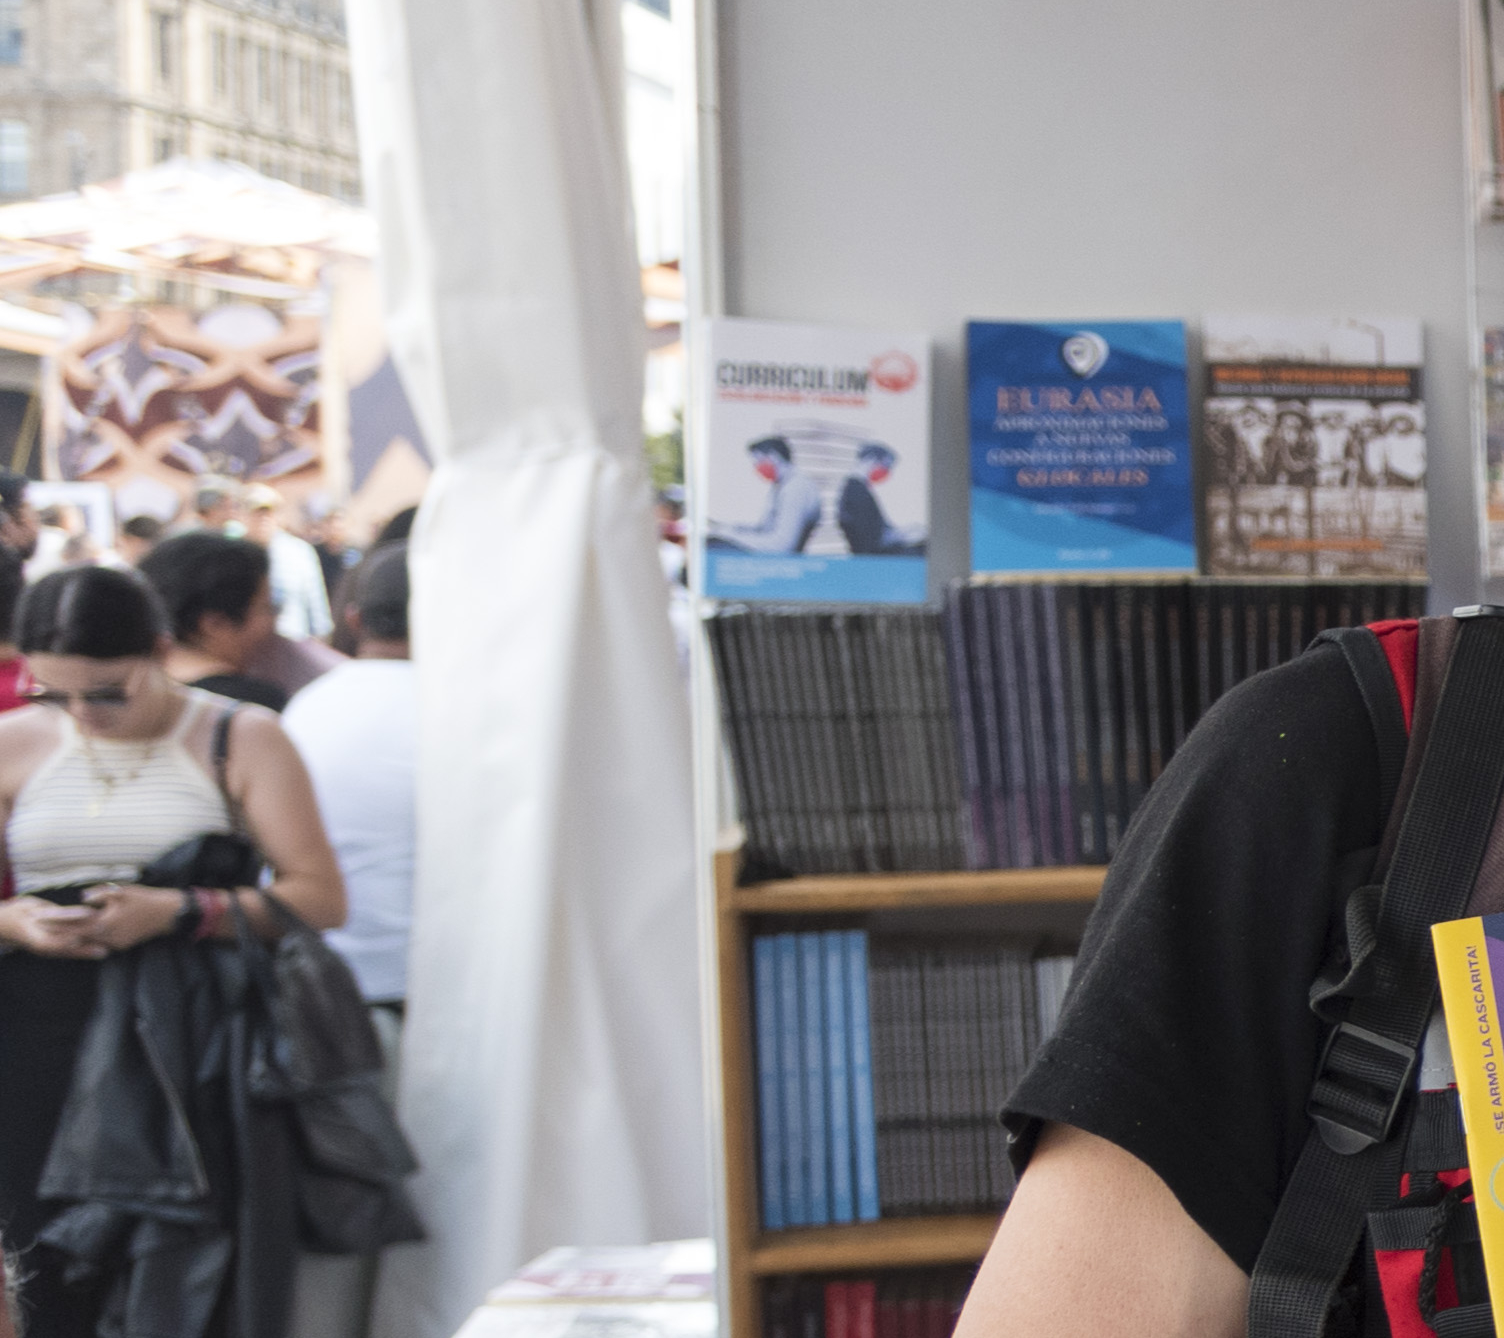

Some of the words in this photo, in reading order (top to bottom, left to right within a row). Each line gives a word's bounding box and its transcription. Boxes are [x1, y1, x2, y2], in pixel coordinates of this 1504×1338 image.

[996, 386, 1163, 413] EURASIA
[1466, 945, 1490, 1034] CASCARITA!
[1480, 1038, 1495, 1059] LA
[1485, 1061, 1504, 1107] ARMÓ
